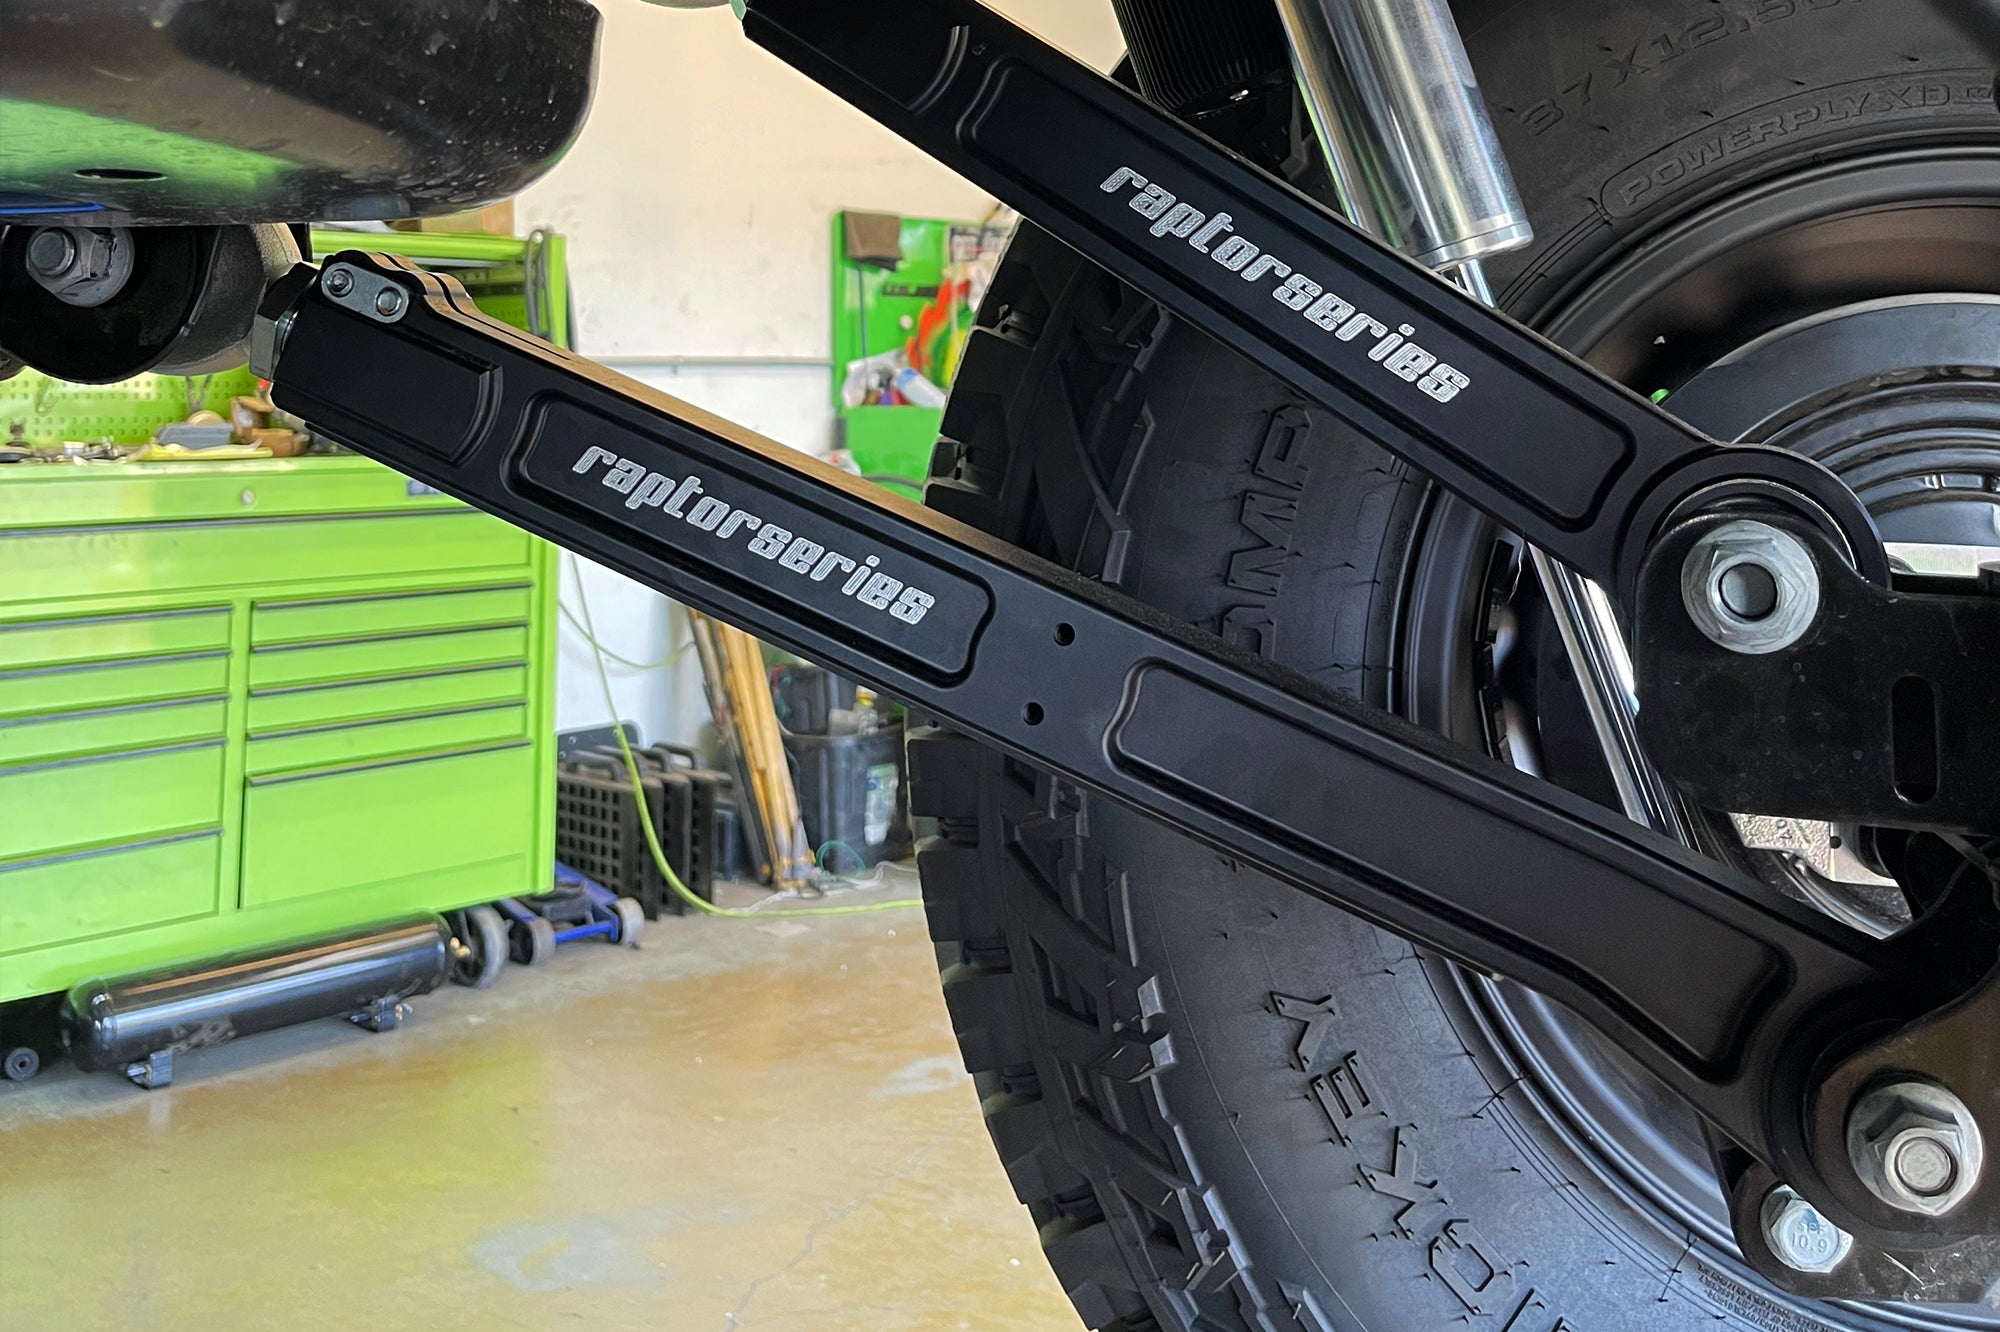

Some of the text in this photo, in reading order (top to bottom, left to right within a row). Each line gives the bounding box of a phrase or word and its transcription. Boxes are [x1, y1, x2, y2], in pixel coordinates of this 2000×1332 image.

[1099, 165, 1471, 404] raptorseries
[571, 445, 936, 625] raptorseries
[1791, 1231, 1828, 1254] 10.9
